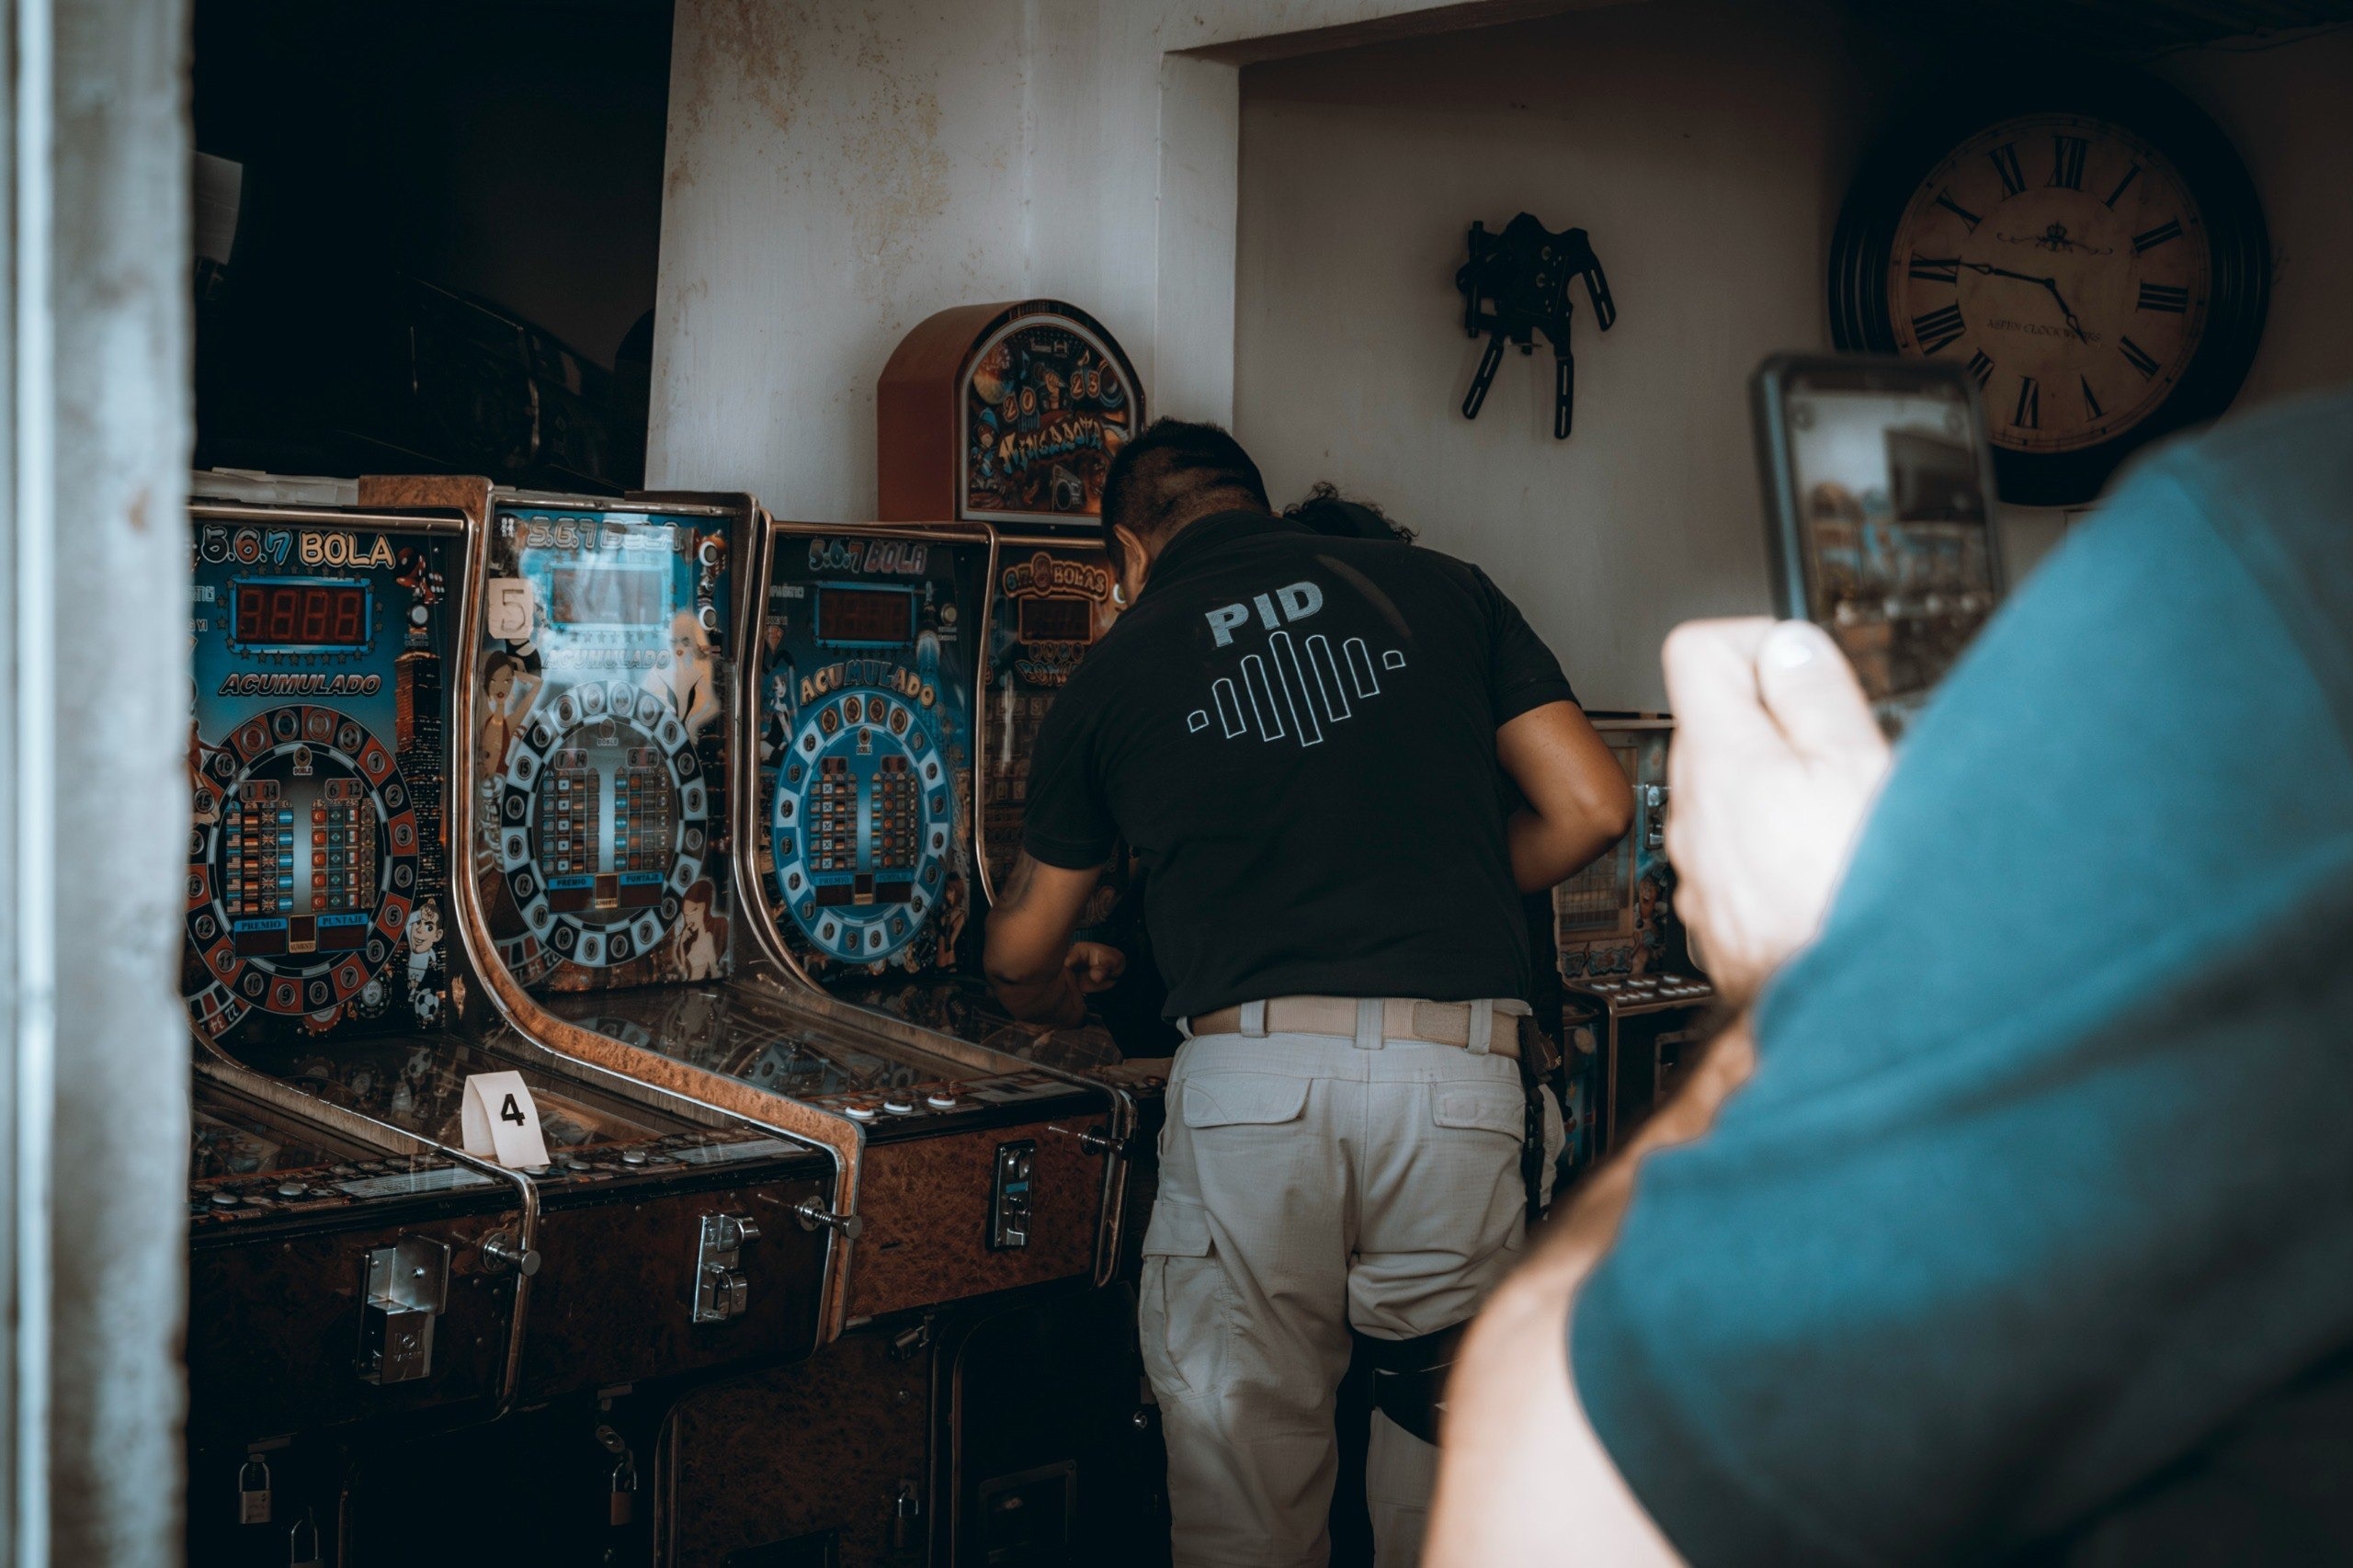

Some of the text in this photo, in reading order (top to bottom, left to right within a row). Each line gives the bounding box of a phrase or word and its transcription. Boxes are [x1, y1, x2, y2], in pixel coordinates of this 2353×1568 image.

[299, 530, 396, 569] BOLA
[864, 540, 928, 574] BOLA
[501, 588, 526, 632] 5
[1205, 581, 1324, 647] PID
[218, 673, 381, 697] ACUMULADO
[800, 659, 936, 709] ACUMULADO
[242, 921, 281, 930] PREMIO
[323, 915, 363, 925] PUNTAJE
[501, 1094, 525, 1126] 4
